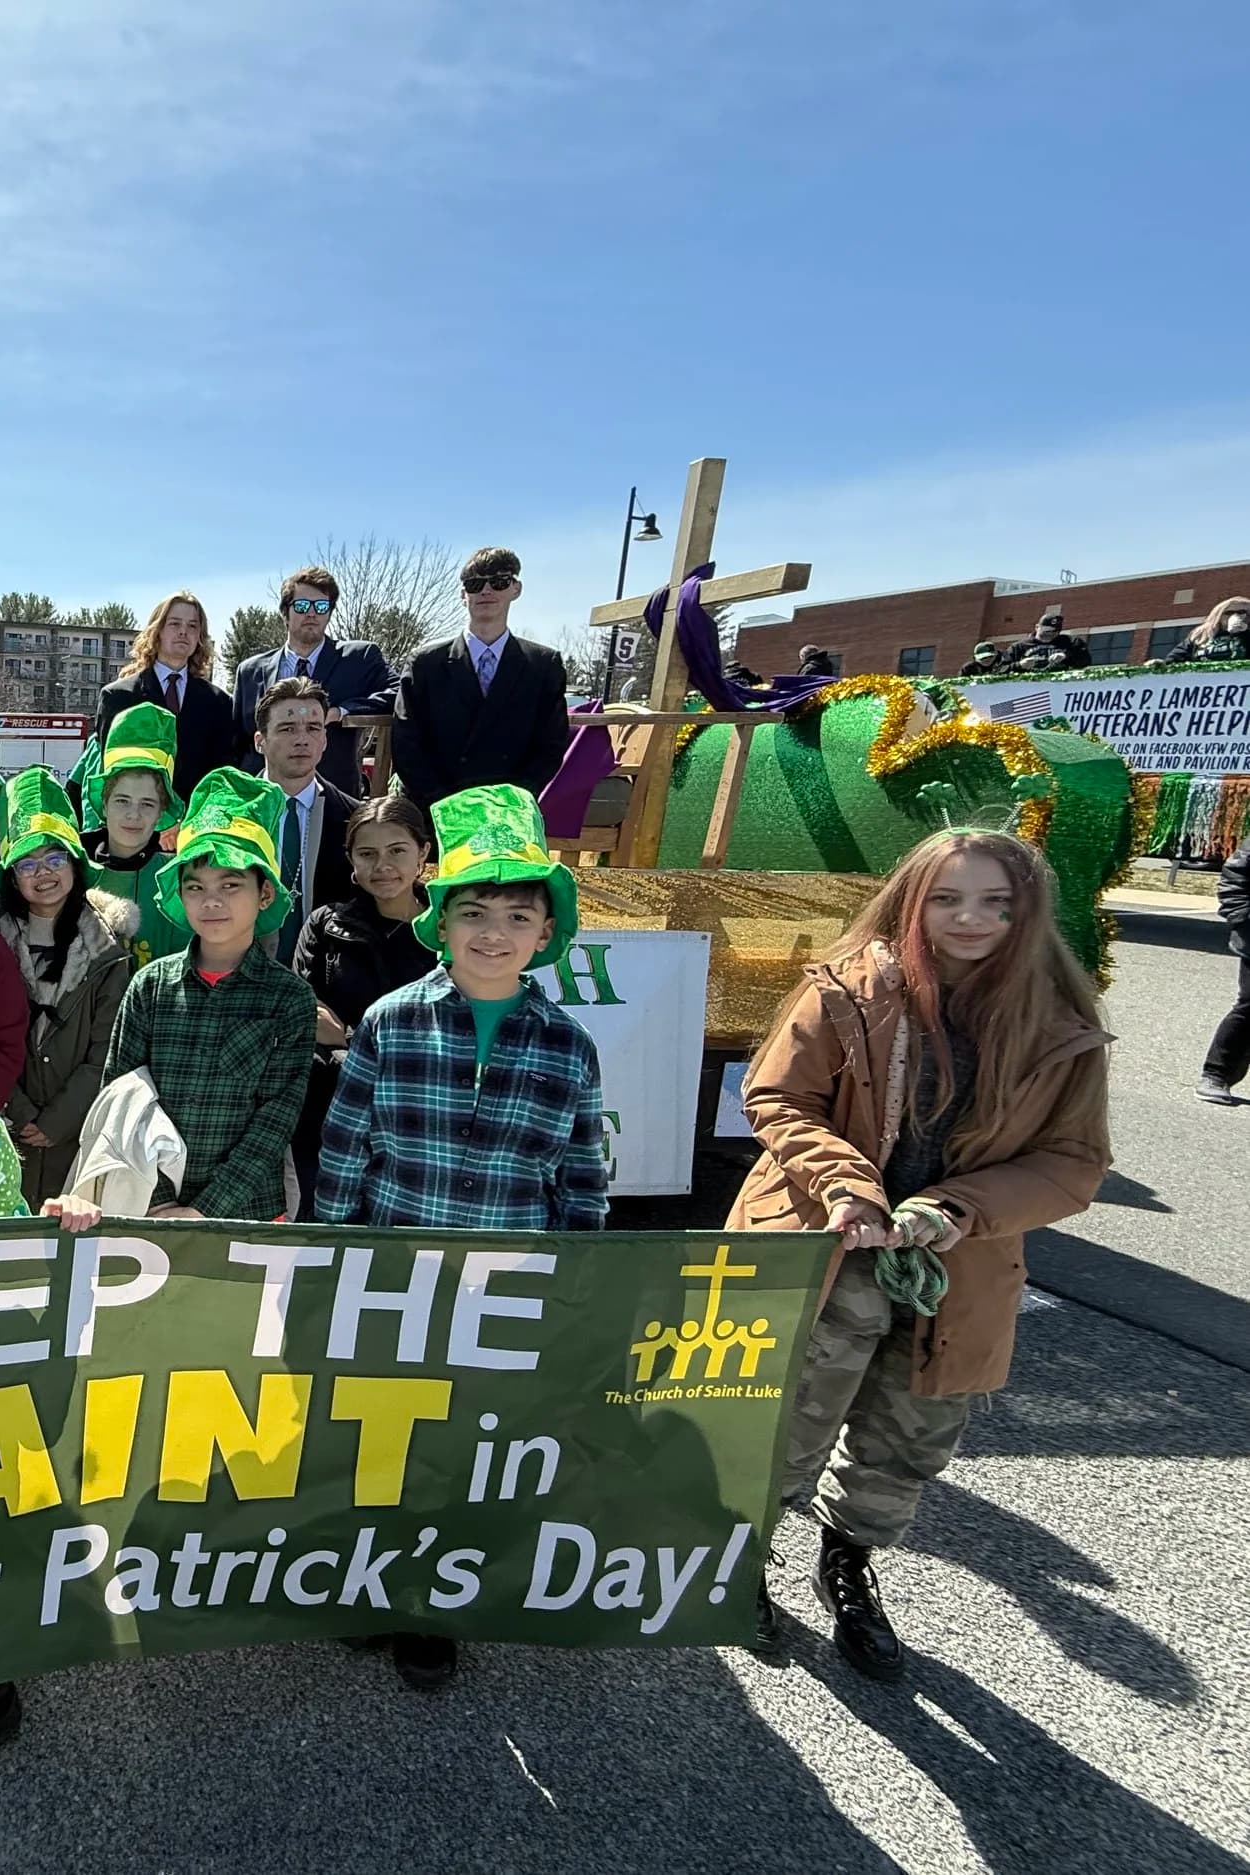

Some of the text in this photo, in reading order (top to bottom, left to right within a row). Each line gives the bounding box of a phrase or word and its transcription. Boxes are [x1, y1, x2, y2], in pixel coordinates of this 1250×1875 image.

[619, 637, 635, 659] S
[1064, 685, 1250, 712] THOMAS P. LAMBERT
[12, 719, 49, 728] RESCUE
[1117, 743, 1131, 755] US
[1133, 743, 1147, 755] ON
[1155, 756, 1181, 769] AND
[1183, 756, 1241, 770] PAVILION
[228, 1241, 557, 1370] THE
[605, 1384, 782, 1405] The Church of Saint Luke
[468, 1413, 561, 1502] in
[40, 1524, 486, 1627] Patrick's
[523, 1521, 752, 1634] Day!
